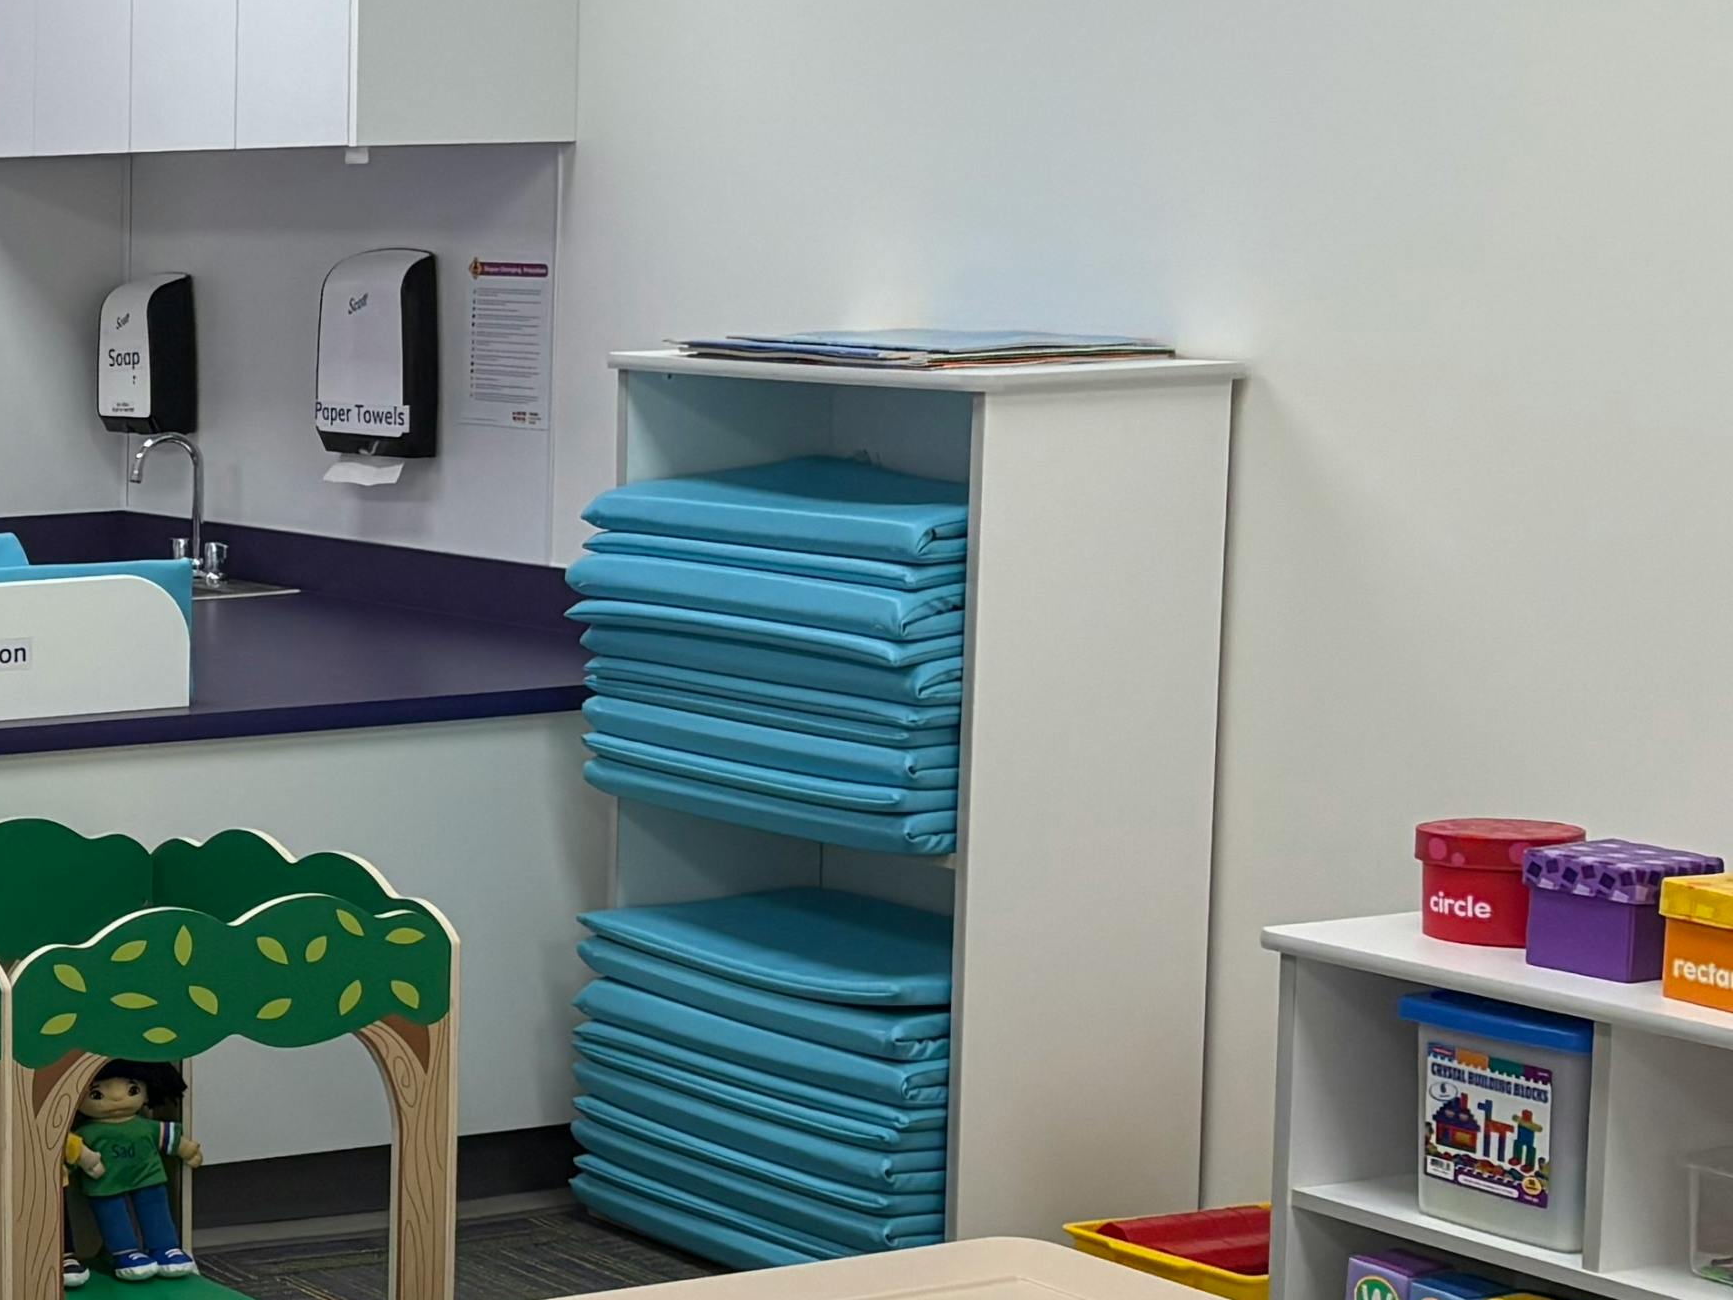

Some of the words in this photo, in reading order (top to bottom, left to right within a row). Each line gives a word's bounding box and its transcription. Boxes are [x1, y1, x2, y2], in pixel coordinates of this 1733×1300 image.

[108, 348, 140, 370] Soap
[315, 401, 352, 426] Paper
[354, 404, 405, 426] Towels
[1428, 891, 1493, 920] circle
[1431, 1062, 1466, 1084] CRYSTAL
[1467, 1071, 1512, 1096] BUILDING
[1513, 1082, 1549, 1104] BLOCKS
[111, 1142, 135, 1158] Sad
